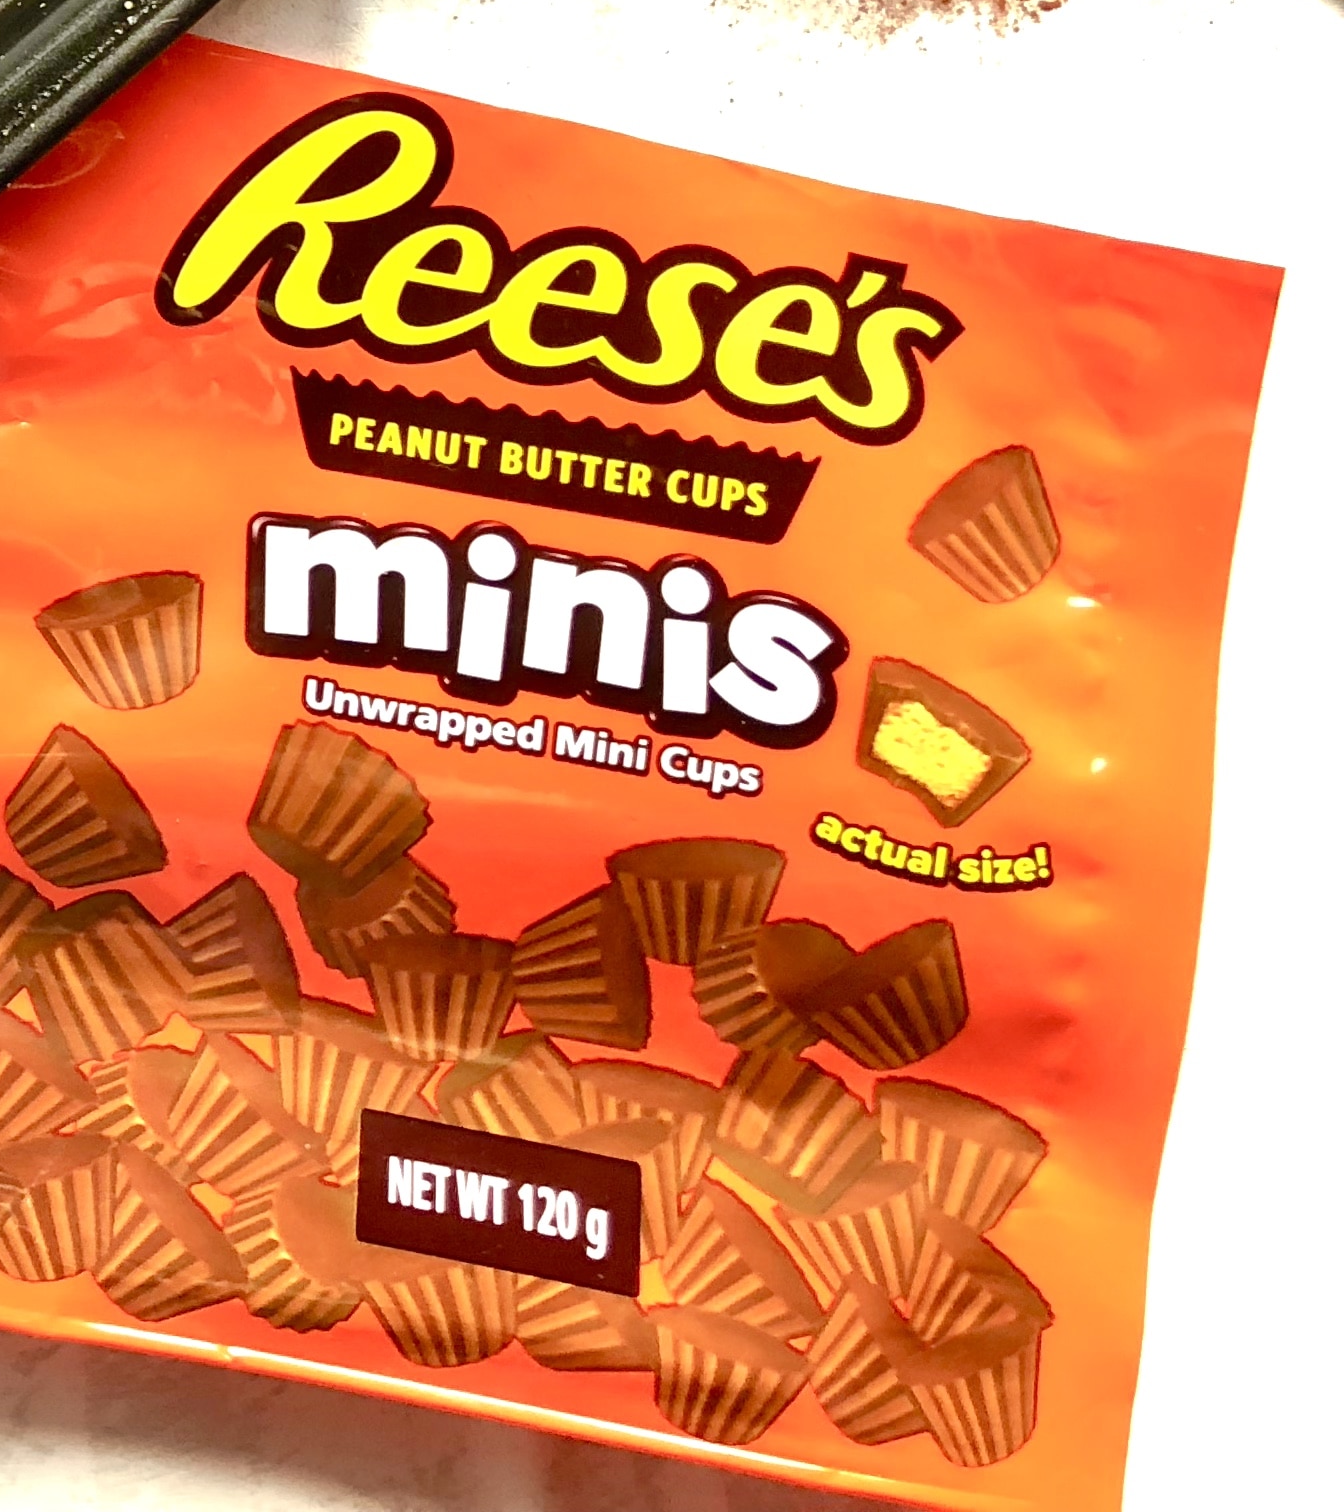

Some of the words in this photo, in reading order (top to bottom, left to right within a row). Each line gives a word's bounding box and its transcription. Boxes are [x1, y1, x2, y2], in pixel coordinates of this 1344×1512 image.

[172, 109, 943, 430] Reese's
[329, 412, 488, 469] PEANUT
[499, 441, 653, 498] BUTTER
[666, 469, 769, 517] CUPS
[263, 524, 833, 726] minis
[305, 678, 545, 752] Unwrapped
[555, 725, 650, 772] Mini
[660, 745, 762, 793] Cups
[814, 815, 949, 879] actual
[957, 846, 1050, 884] size!
[387, 1155, 451, 1214] NET
[455, 1169, 509, 1226] WT
[518, 1183, 579, 1241] 120
[586, 1207, 609, 1261] g
